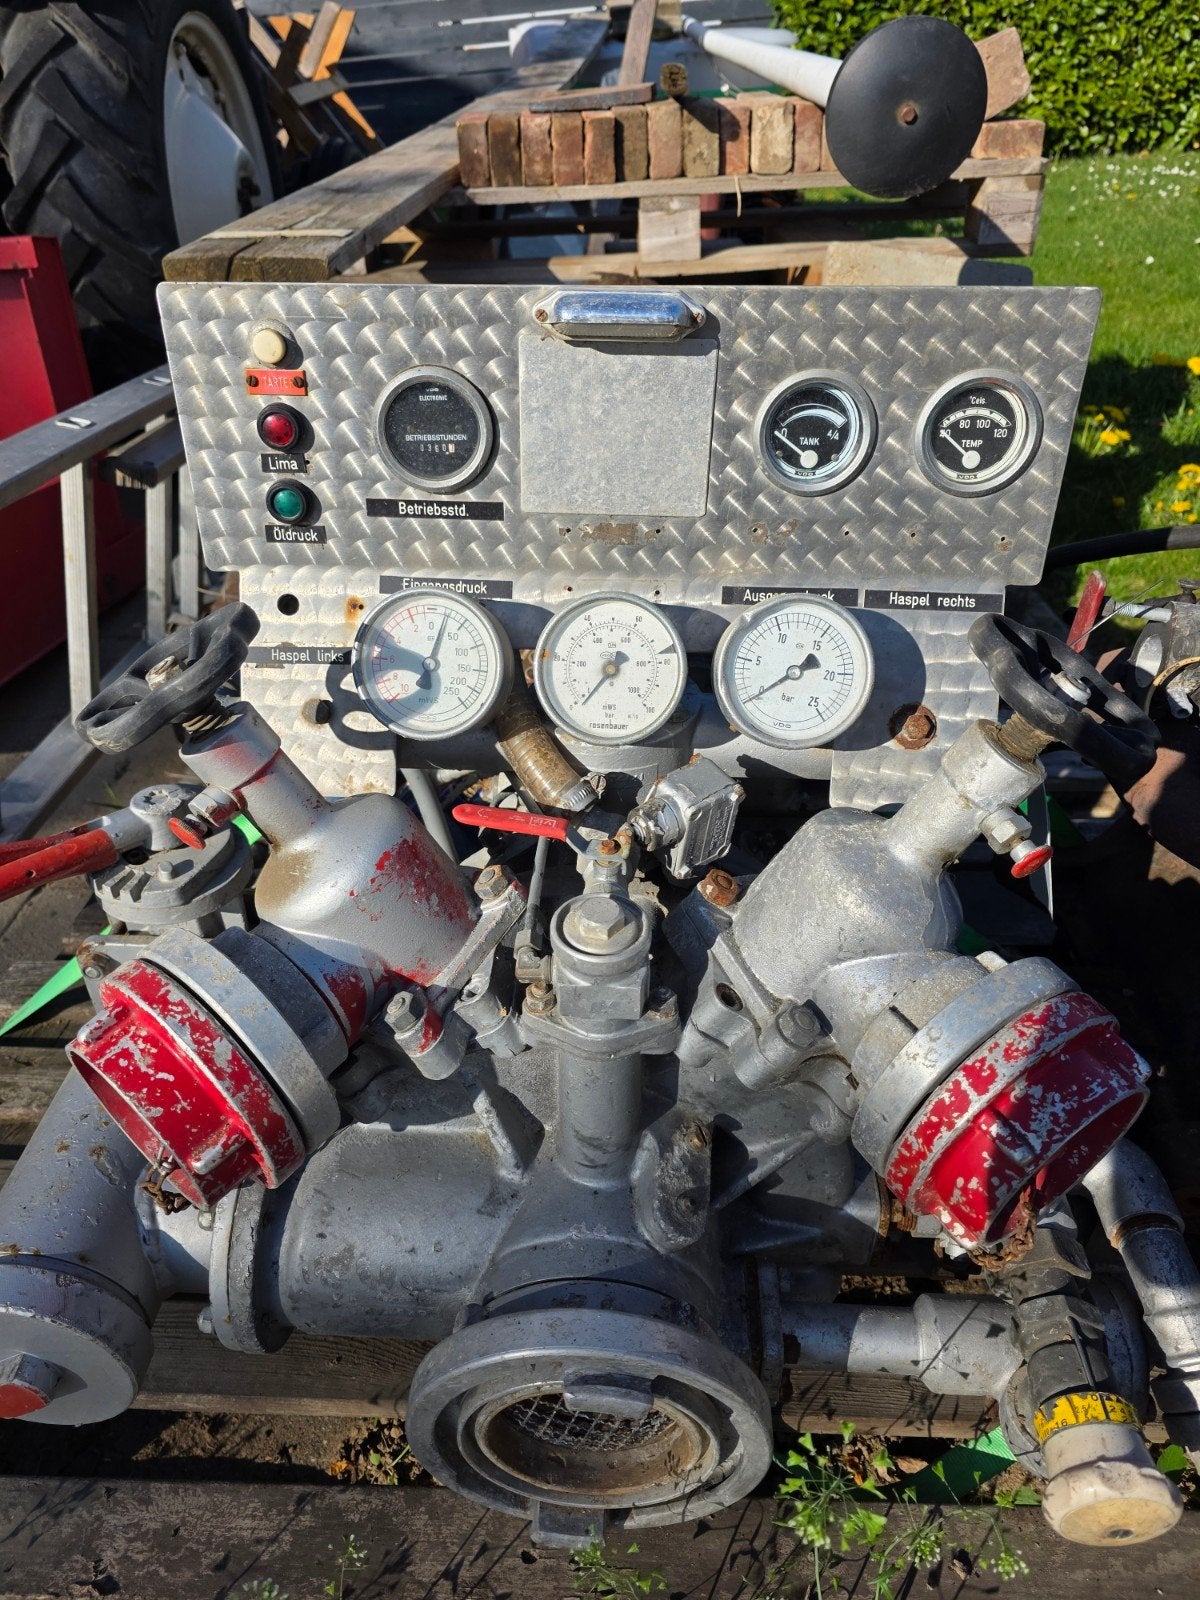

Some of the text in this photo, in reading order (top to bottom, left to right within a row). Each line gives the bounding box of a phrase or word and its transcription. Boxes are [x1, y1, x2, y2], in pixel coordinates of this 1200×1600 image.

[959, 419, 991, 429] 80 100
[994, 428, 1008, 438] 120
[799, 437, 820, 446] TANK
[961, 439, 983, 448] TEMP
[268, 456, 299, 471] Lima
[398, 501, 469, 517] Betriebsstd.
[273, 526, 318, 541] Öldruck
[889, 591, 976, 609] Haspel rechts
[413, 624, 419, 633] 2
[428, 621, 434, 630] 0
[447, 632, 459, 641] 50
[777, 633, 787, 644] 10
[812, 640, 821, 651] 15
[271, 648, 345, 663] Haspel links
[455, 647, 469, 656] 100
[390, 655, 396, 663] 6
[755, 656, 762, 666] 5
[457, 664, 471, 673] 150
[823, 669, 835, 682] 20
[450, 676, 467, 686] 200
[400, 683, 409, 693] 10
[443, 686, 460, 696] 250
[418, 696, 439, 704] mWS
[781, 692, 795, 703] bar
[807, 695, 820, 708] 25
[604, 711, 614, 719] bar
[589, 719, 629, 731] rosenbauer
[772, 720, 792, 729] VDO
